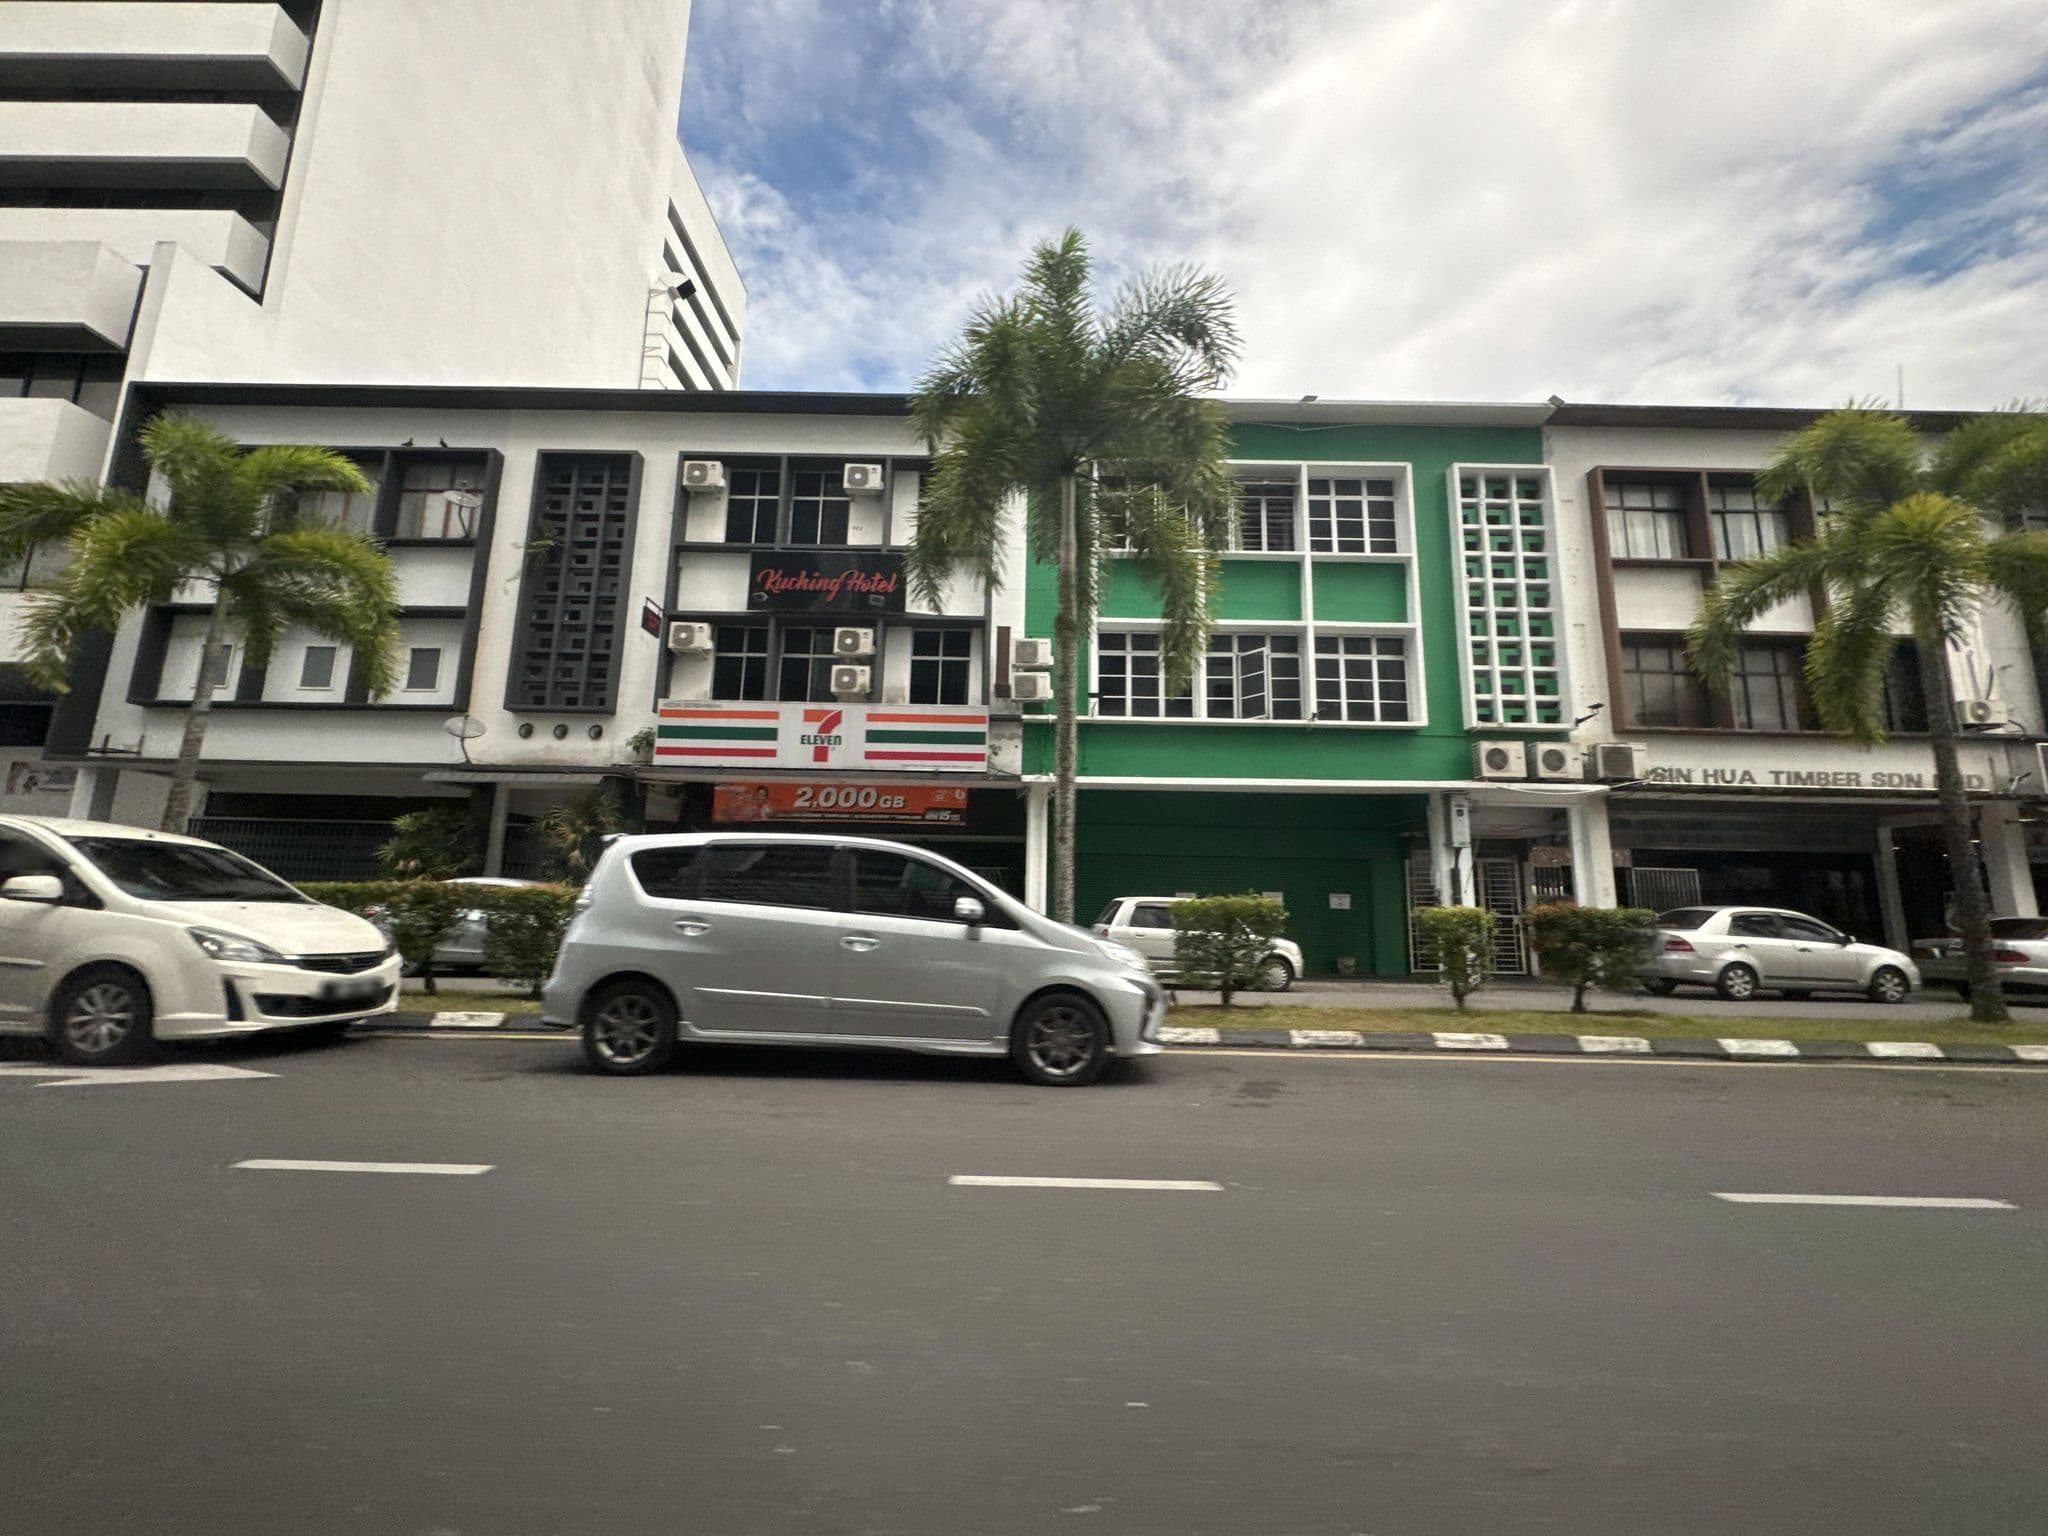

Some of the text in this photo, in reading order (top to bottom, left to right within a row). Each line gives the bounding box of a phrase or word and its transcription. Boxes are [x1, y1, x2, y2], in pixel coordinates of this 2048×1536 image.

[756, 568, 898, 602] Kuching Hotel
[803, 709, 843, 762] 7
[1702, 768, 1757, 785] HUA
[1768, 770, 1862, 787] TIMBER
[1871, 771, 1923, 788] SDN
[793, 786, 905, 809] 2,000 GB
